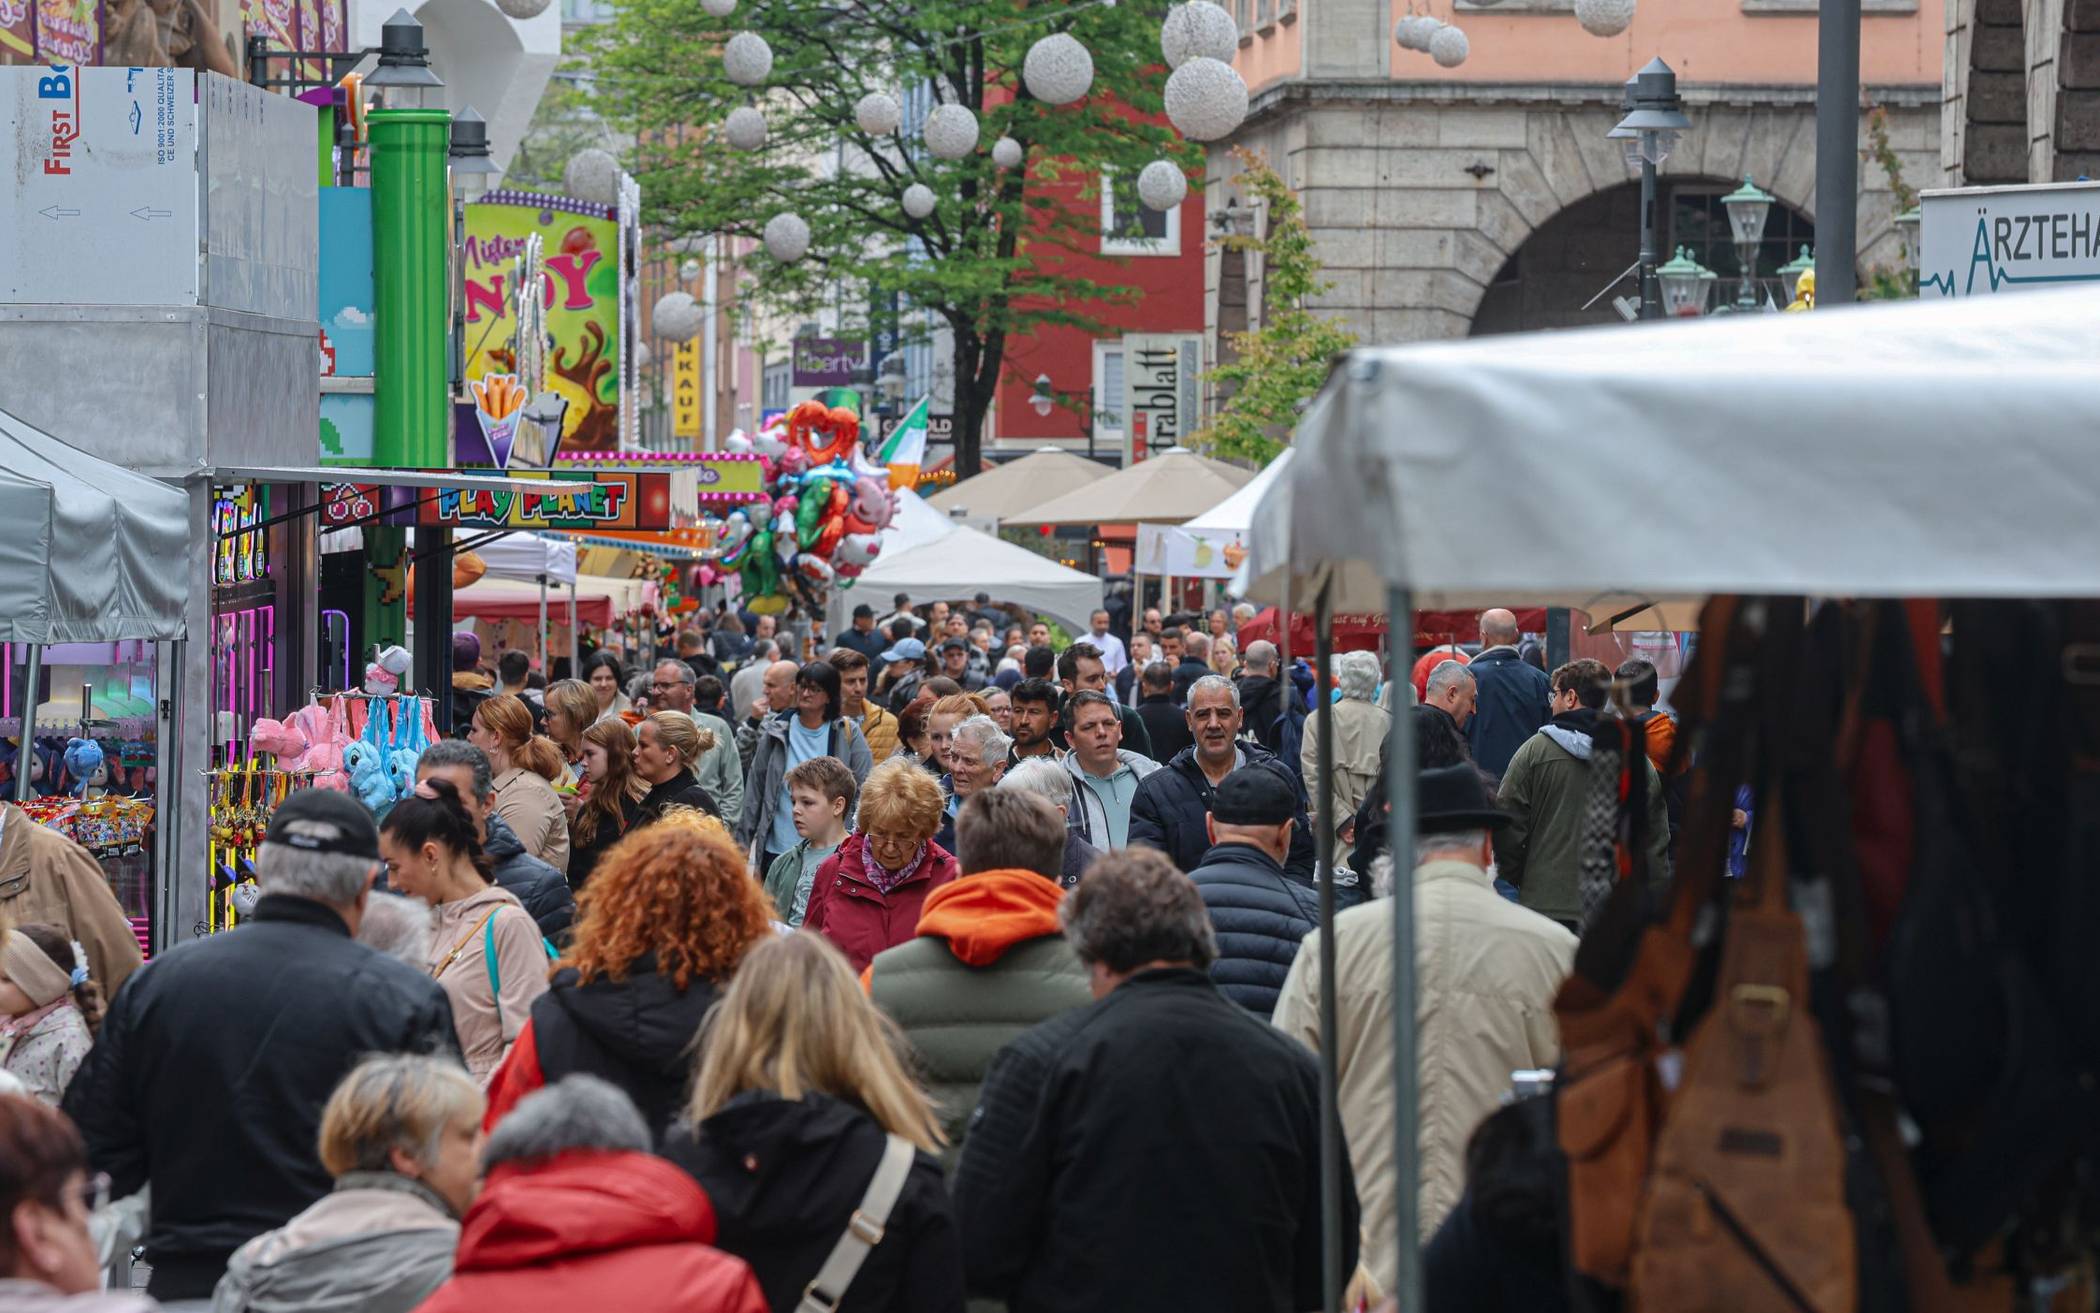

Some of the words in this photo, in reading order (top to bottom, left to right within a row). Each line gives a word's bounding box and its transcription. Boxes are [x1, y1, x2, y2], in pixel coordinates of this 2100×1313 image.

[38, 64, 71, 99] B
[167, 76, 175, 127] SCHWEIZER
[44, 110, 71, 175] FIRST
[167, 129, 175, 147] UND
[167, 149, 175, 161] CE
[157, 150, 166, 165] ISO
[440, 486, 514, 524] PLAY
[520, 482, 627, 520] PLANET
